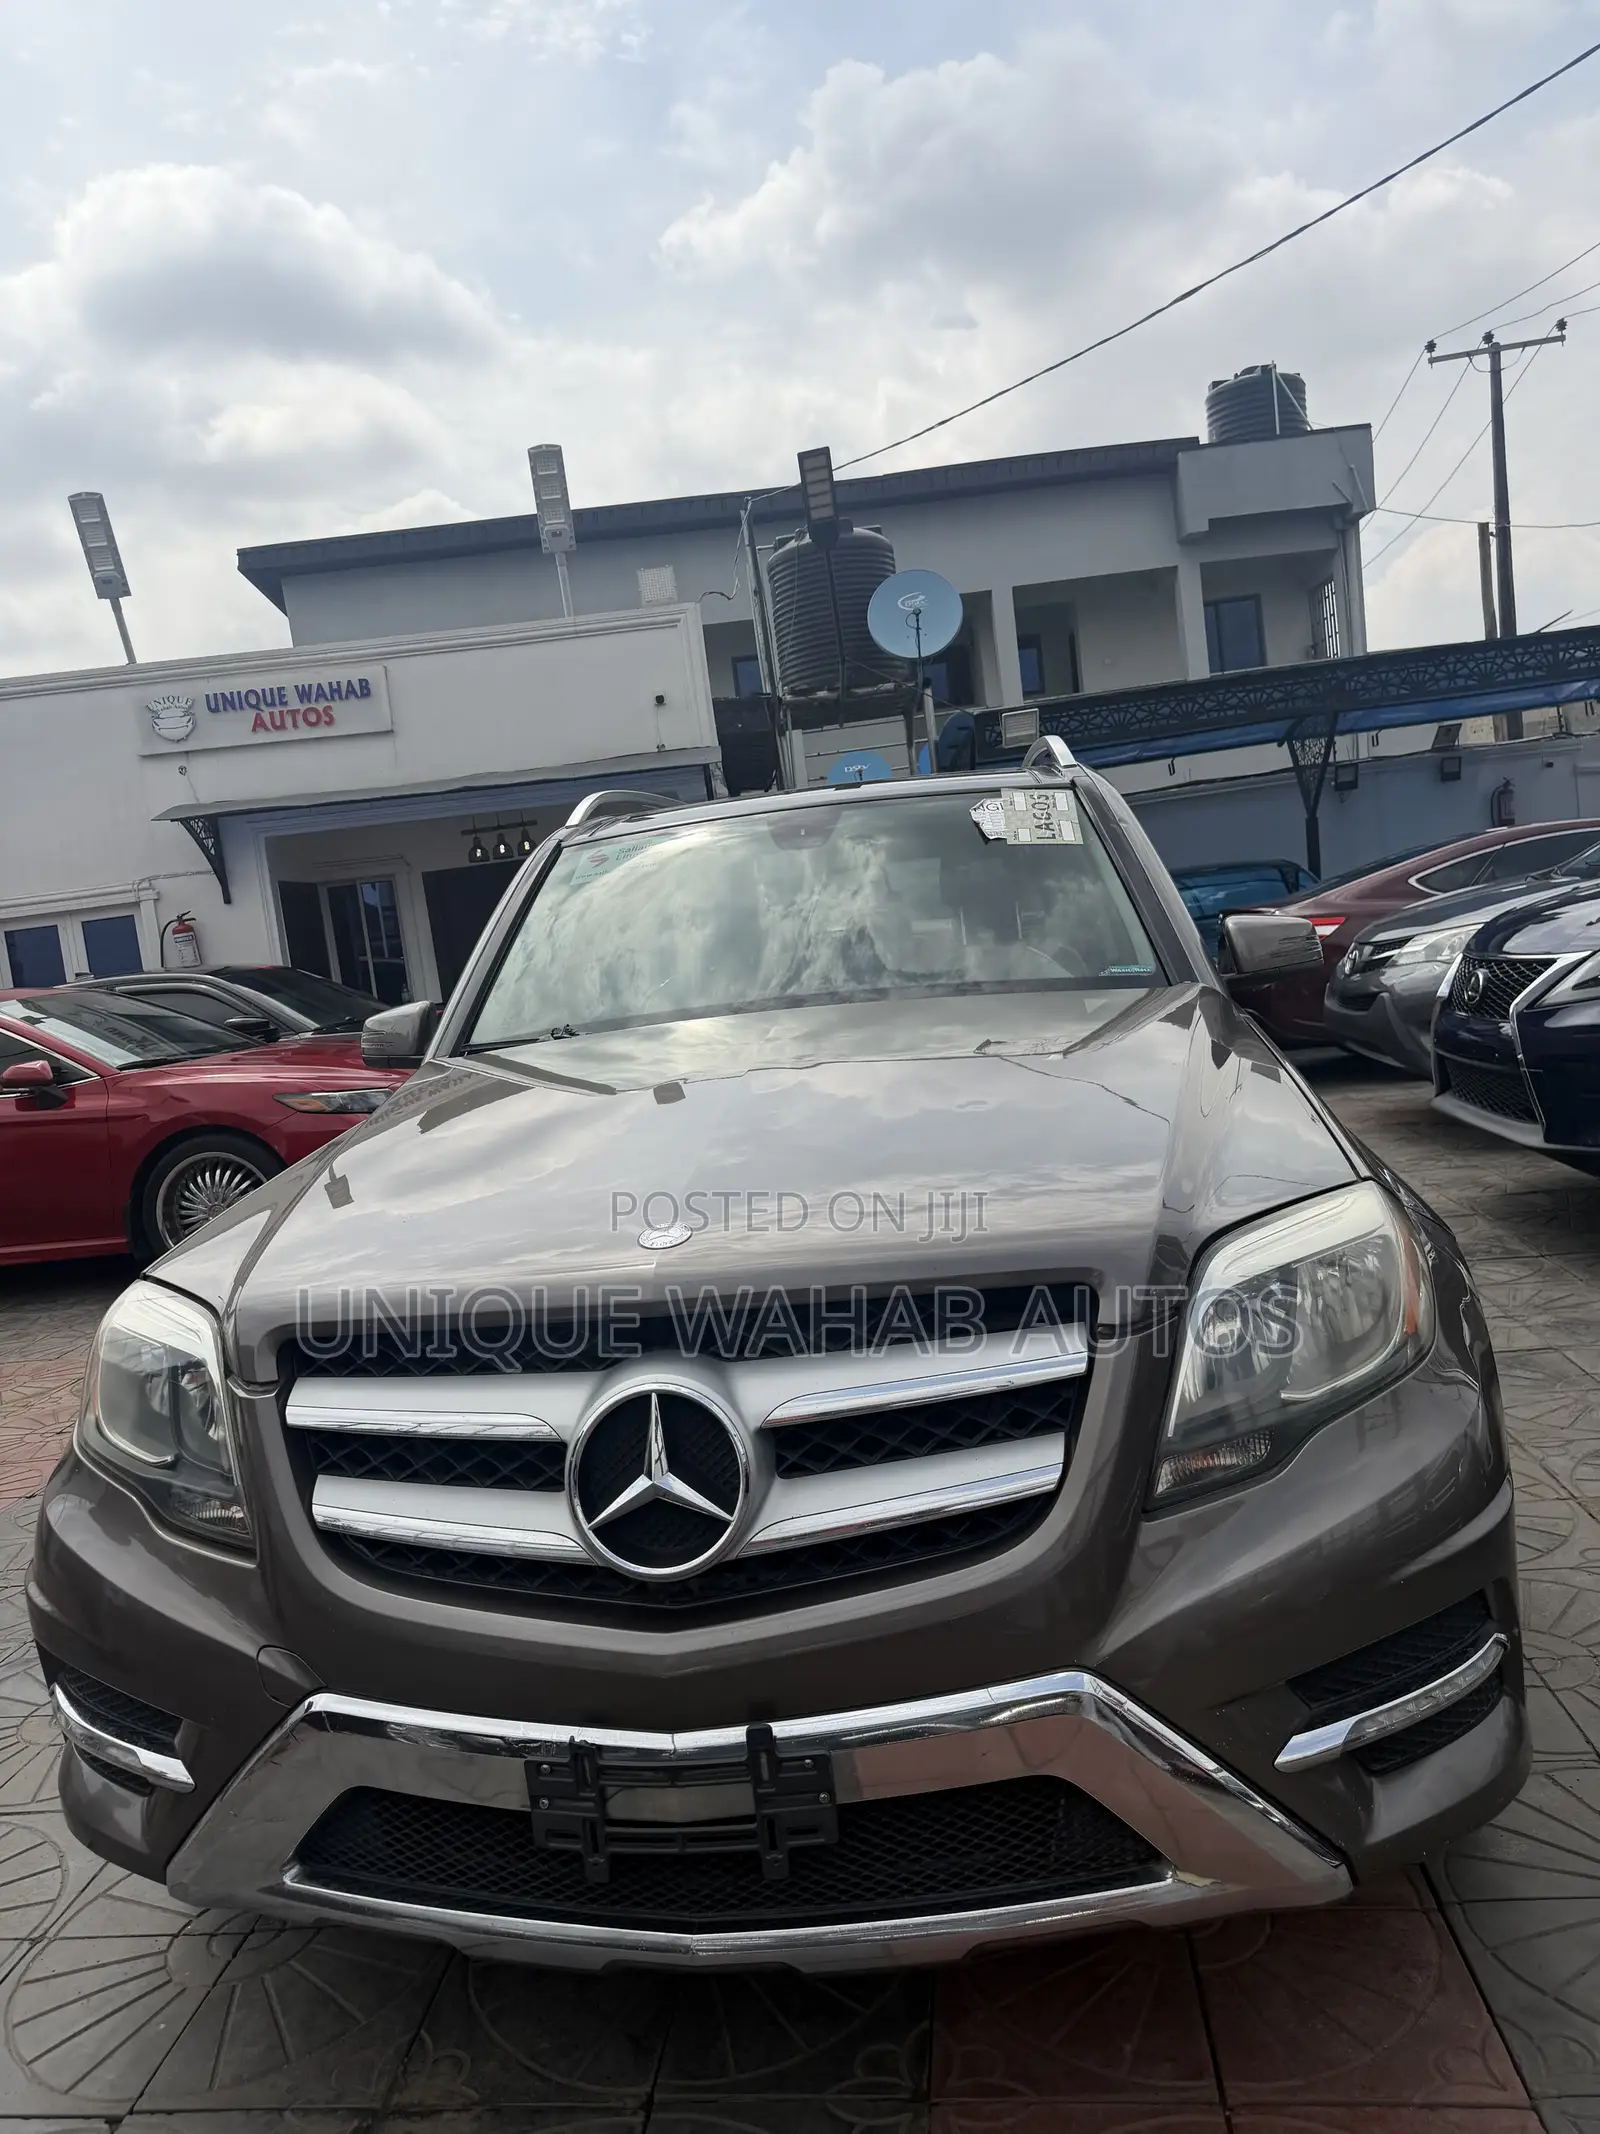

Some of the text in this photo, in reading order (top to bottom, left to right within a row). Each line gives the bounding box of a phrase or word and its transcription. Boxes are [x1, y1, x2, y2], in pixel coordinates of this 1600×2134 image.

[145, 694, 194, 712] UNIQUE
[204, 678, 372, 713] UNIQUE WAHAB
[251, 705, 334, 733] AUTOS
[1030, 793, 1057, 840] LAGOS
